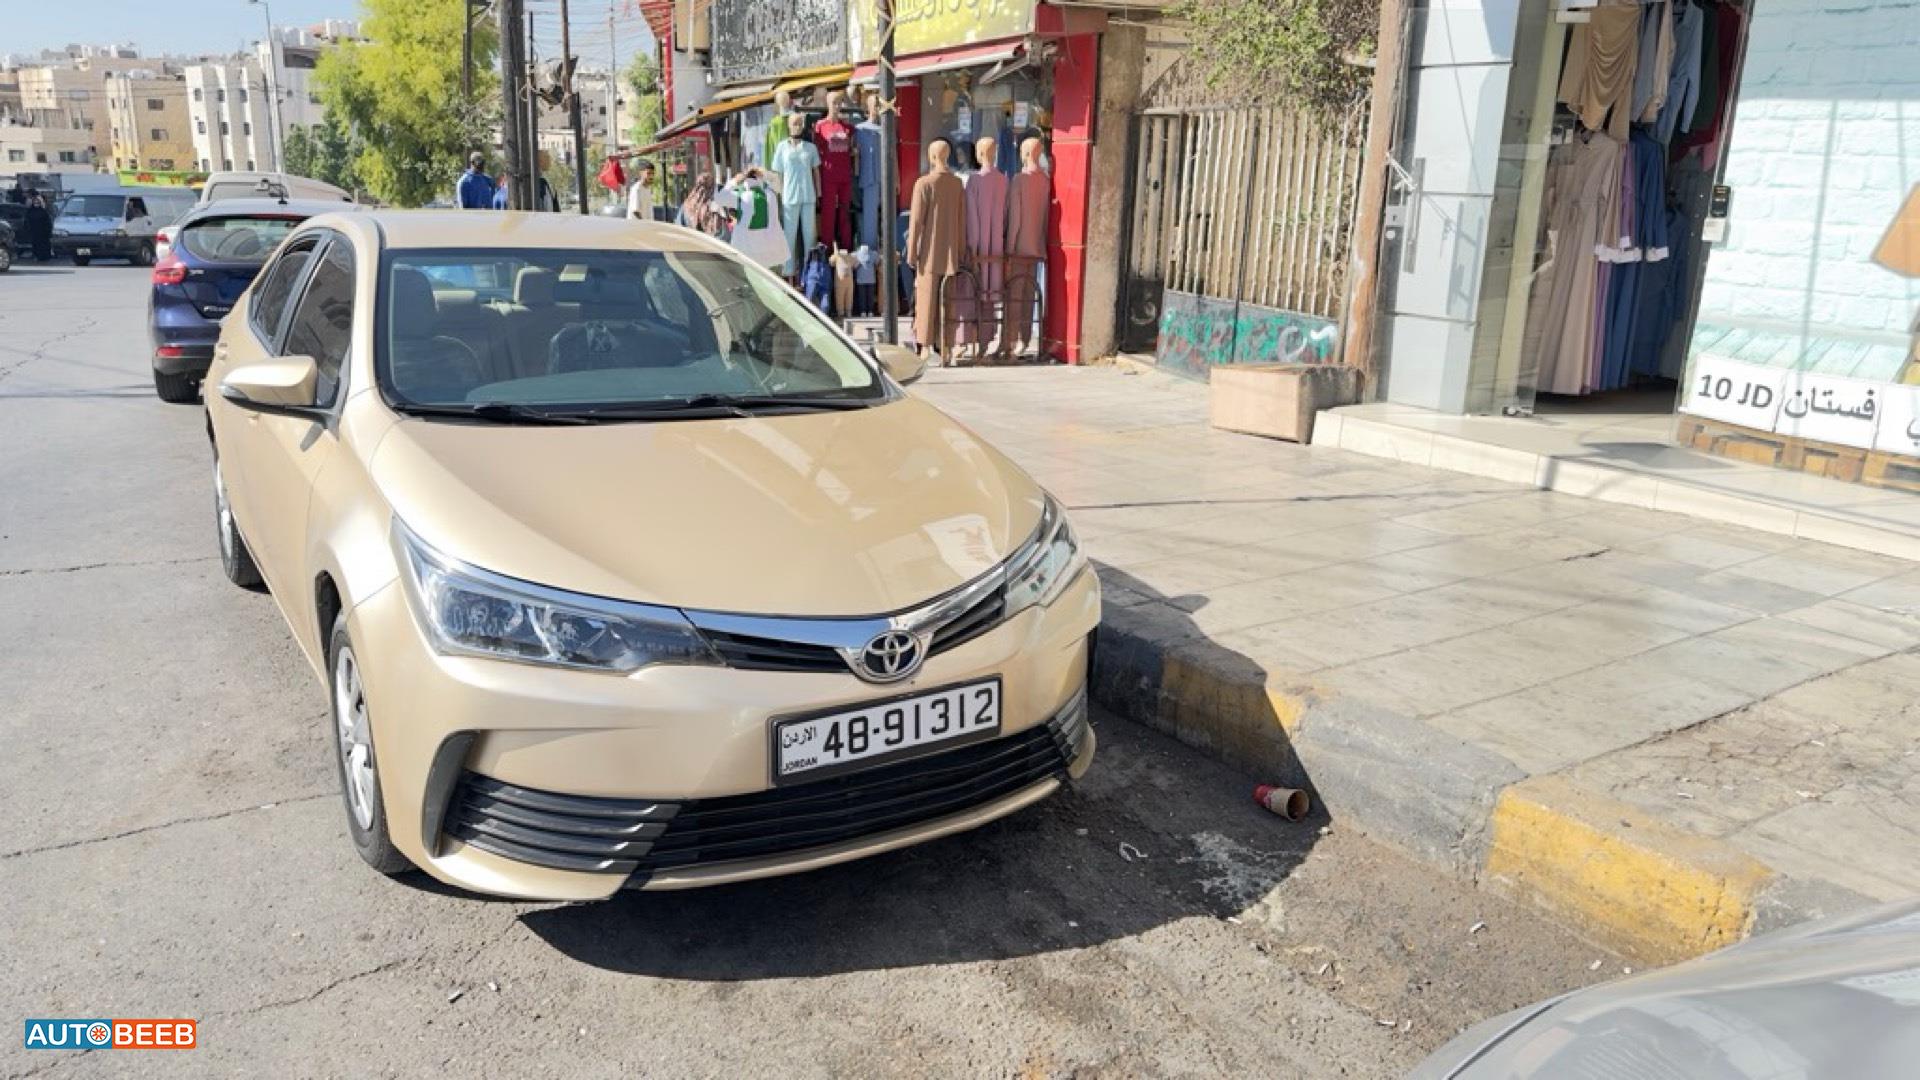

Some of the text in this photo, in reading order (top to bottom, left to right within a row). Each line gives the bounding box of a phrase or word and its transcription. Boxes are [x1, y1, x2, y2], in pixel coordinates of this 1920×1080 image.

[1698, 374, 1773, 408] 10 JD
[1784, 386, 1876, 421] فستان
[822, 687, 993, 758] 48-91312
[783, 756, 818, 772] JORDAN
